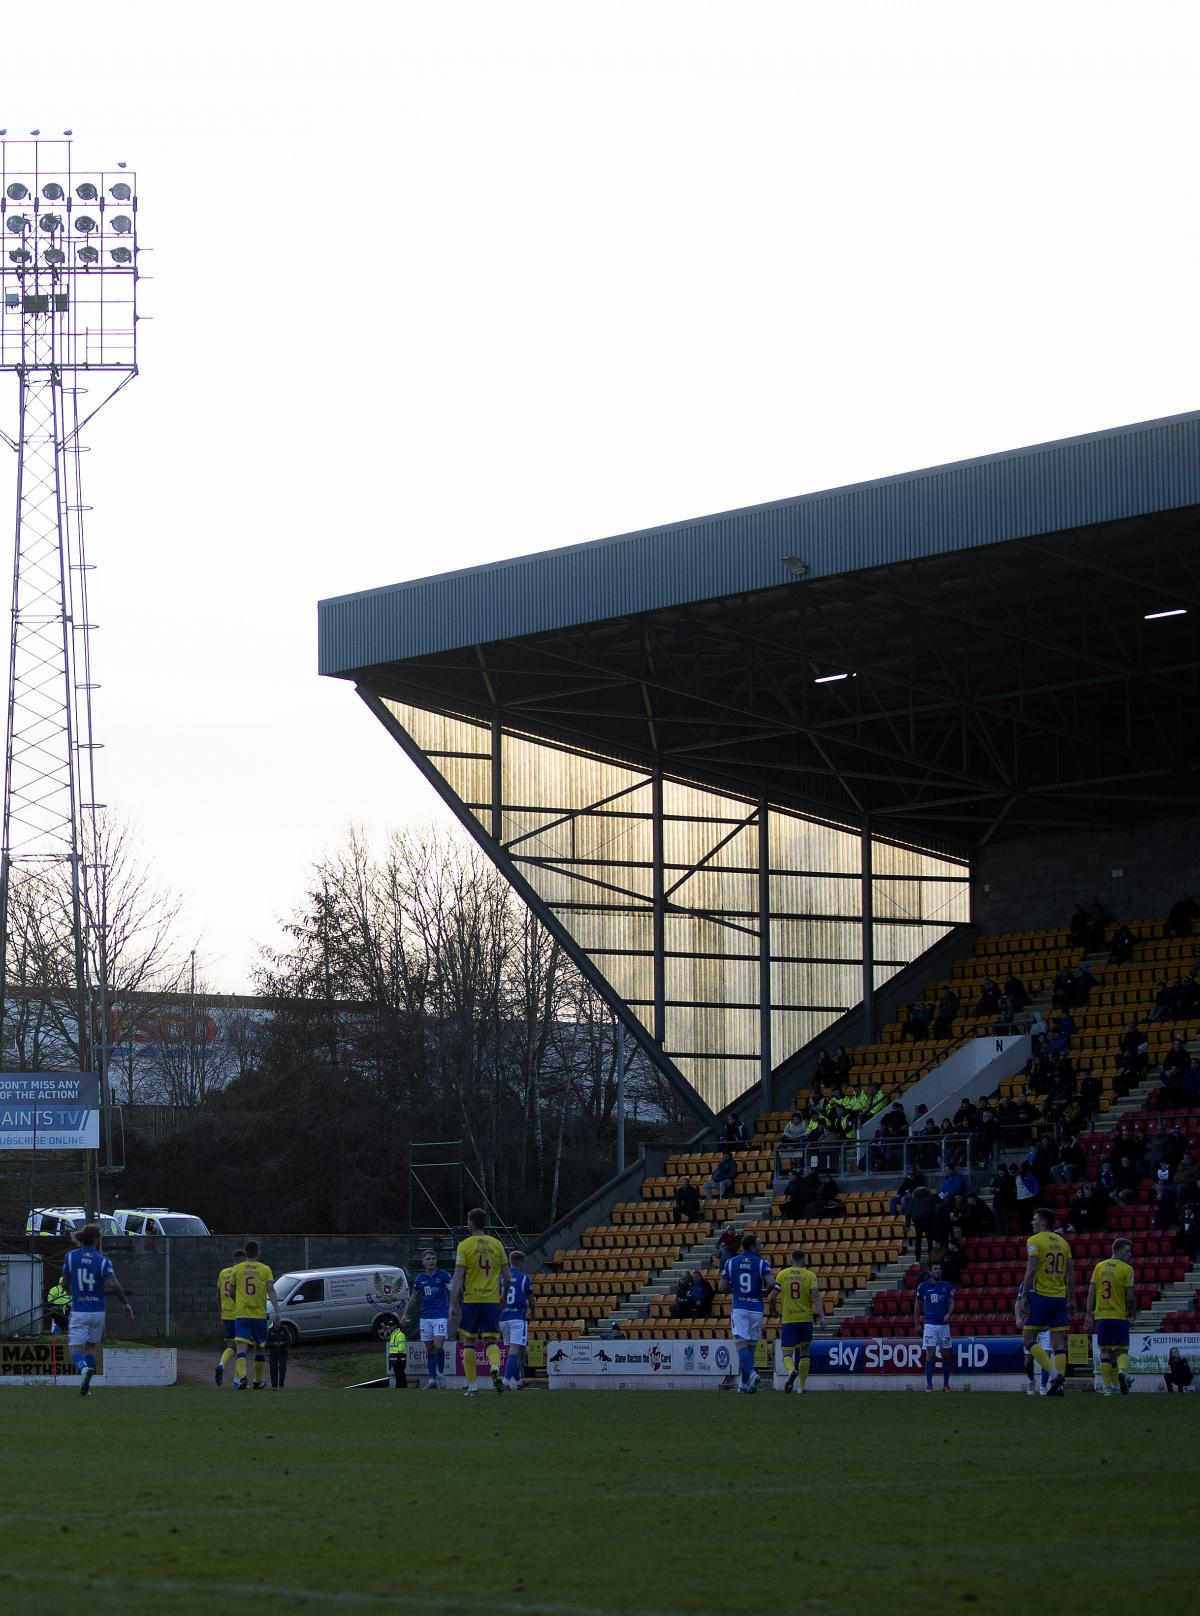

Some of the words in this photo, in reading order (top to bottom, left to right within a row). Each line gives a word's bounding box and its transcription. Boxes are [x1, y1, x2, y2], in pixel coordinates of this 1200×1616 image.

[996, 1039, 1003, 1052] N
[0, 1091, 14, 1100] OF
[16, 1091, 35, 1100] THE
[38, 1090, 79, 1100] ACTION!
[30, 1080, 56, 1090] MISS
[58, 1080, 81, 1090] ANY
[48, 1136, 85, 1145] ONLINE
[479, 1254, 491, 1279] 4
[1045, 1252, 1065, 1275] 30
[77, 1268, 96, 1292] 14
[245, 1276, 256, 1297] 6
[739, 1272, 752, 1294] 9
[1101, 1280, 1112, 1300] 3
[506, 1286, 516, 1305] 8
[790, 1281, 801, 1301] 8
[1153, 1337, 1182, 1345] SCOTTISH
[2, 1345, 64, 1362] MADE
[828, 1342, 860, 1371] sky
[957, 1343, 989, 1368] HD
